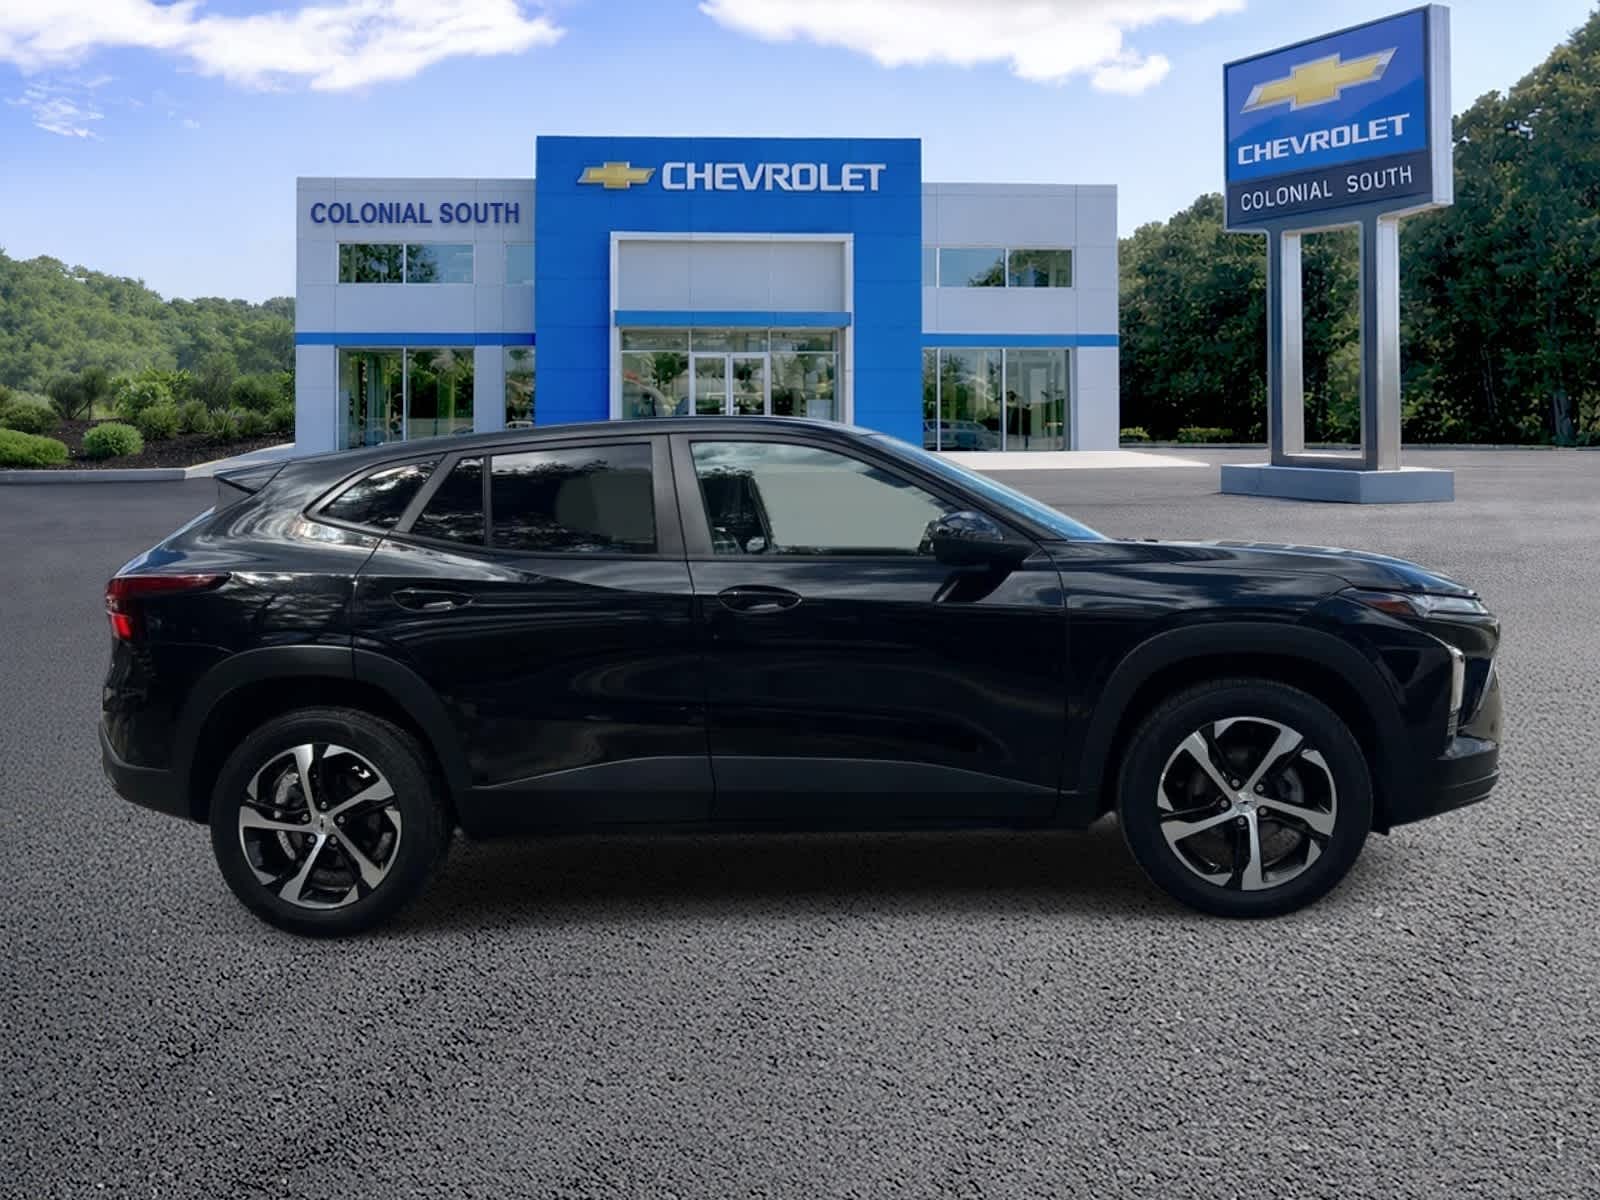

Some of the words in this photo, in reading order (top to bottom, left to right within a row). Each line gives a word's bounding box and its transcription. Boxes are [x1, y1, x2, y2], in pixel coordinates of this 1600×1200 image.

[1238, 113, 1410, 165] CHEVROLET
[661, 162, 887, 192] CHEVROLET
[1241, 180, 1333, 211] COLONIAL
[1347, 165, 1412, 193] SOUTH
[310, 202, 432, 225] COLONIAL
[439, 202, 520, 225] SOUTH
